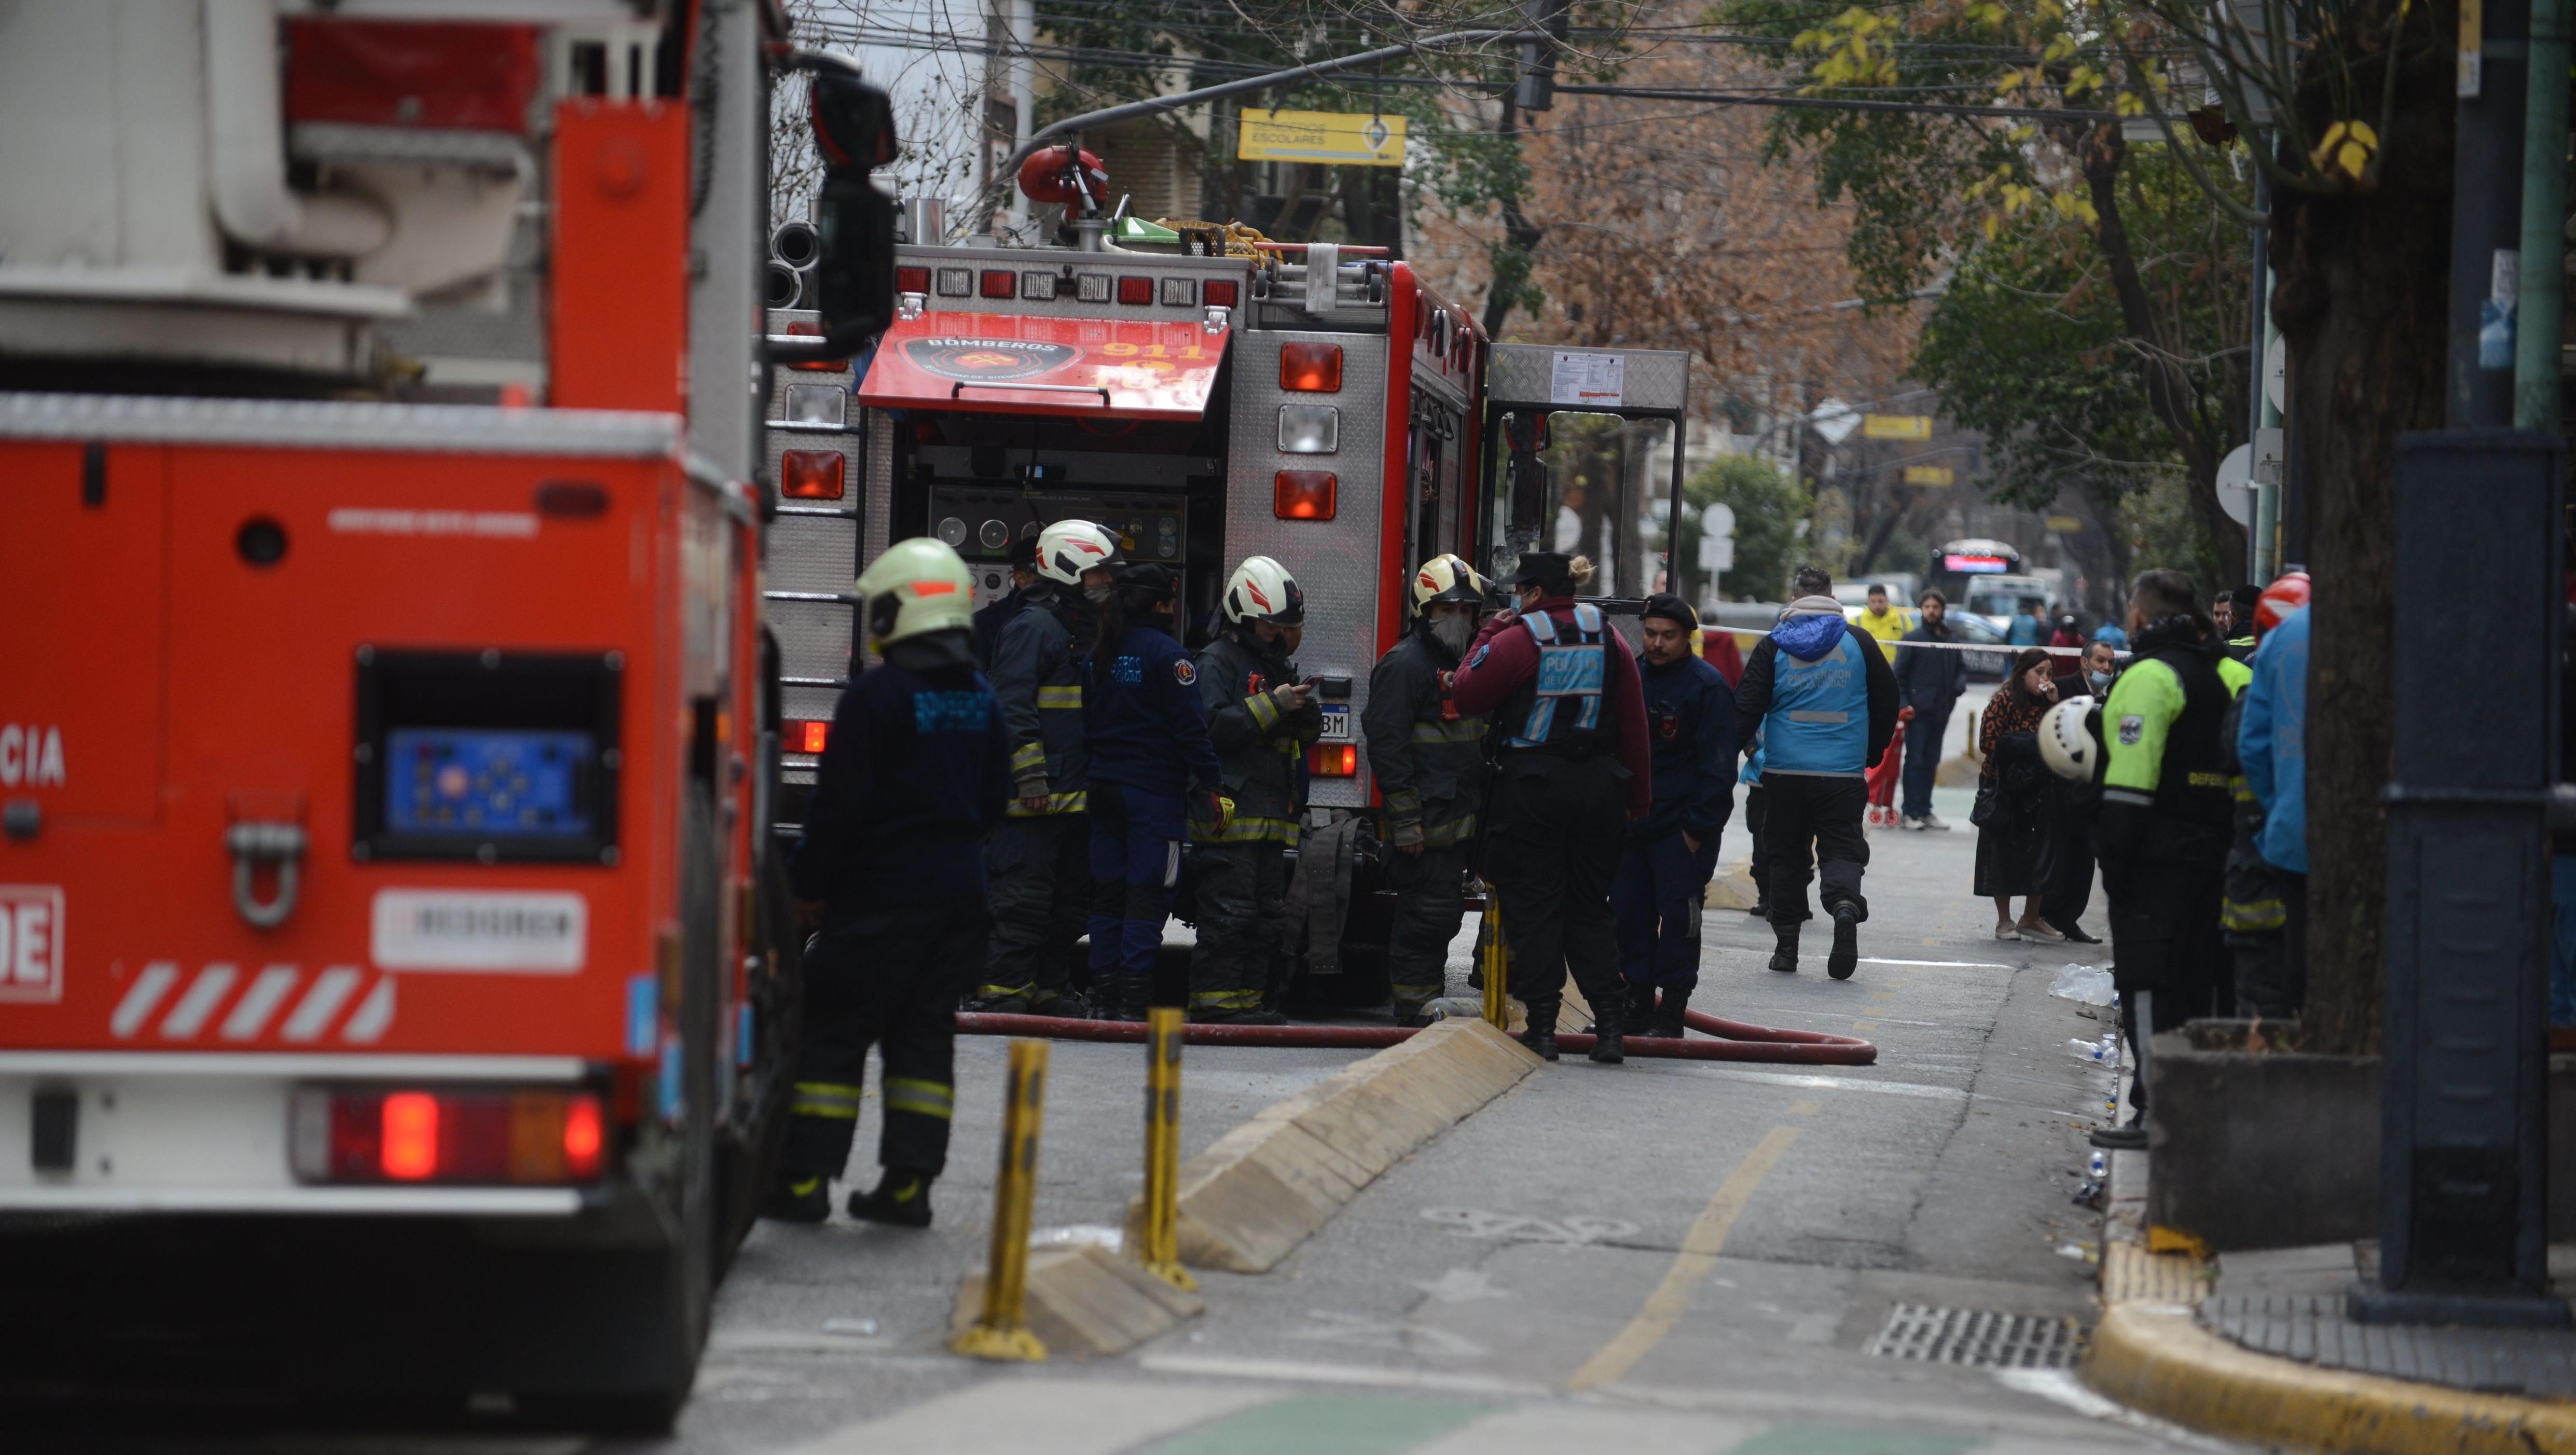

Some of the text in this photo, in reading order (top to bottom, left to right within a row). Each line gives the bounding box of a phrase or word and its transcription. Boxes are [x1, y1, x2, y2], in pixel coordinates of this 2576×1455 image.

[1253, 122, 1326, 134] SENDEROS
[1252, 133, 1325, 145] ESCOLARES
[927, 339, 1058, 351] BOMBEROS
[1104, 342, 1206, 359] 911
[1544, 675, 1555, 685] DE
[0, 720, 67, 788] CIA
